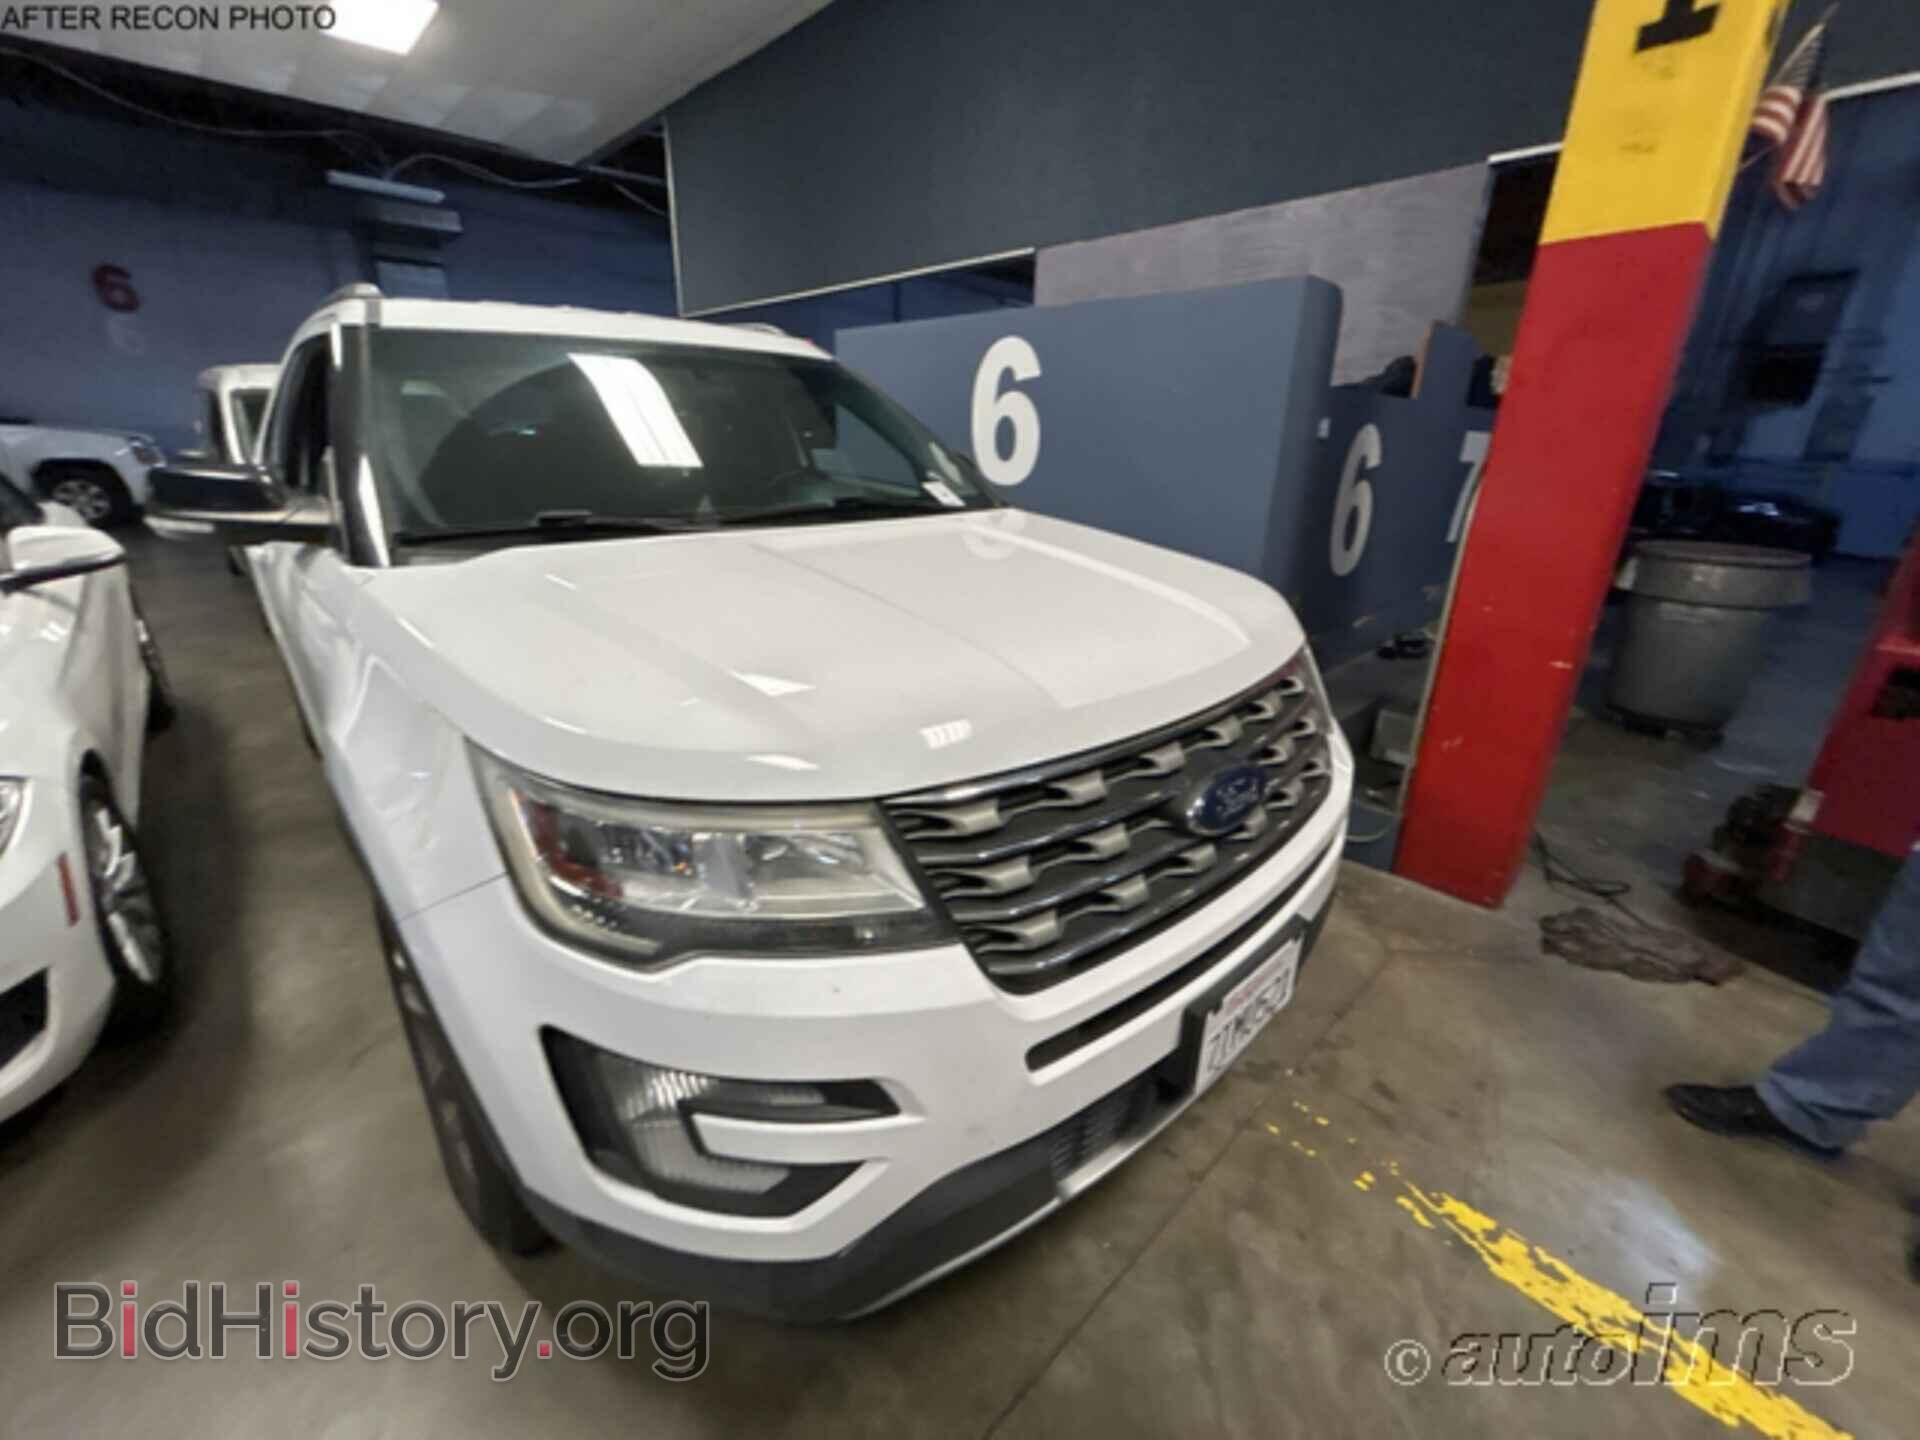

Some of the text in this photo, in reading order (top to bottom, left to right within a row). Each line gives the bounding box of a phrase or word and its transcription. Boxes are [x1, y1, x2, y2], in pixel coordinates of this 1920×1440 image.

[93, 264, 141, 314] 6
[971, 336, 1041, 486] 6
[1329, 423, 1381, 576] 6
